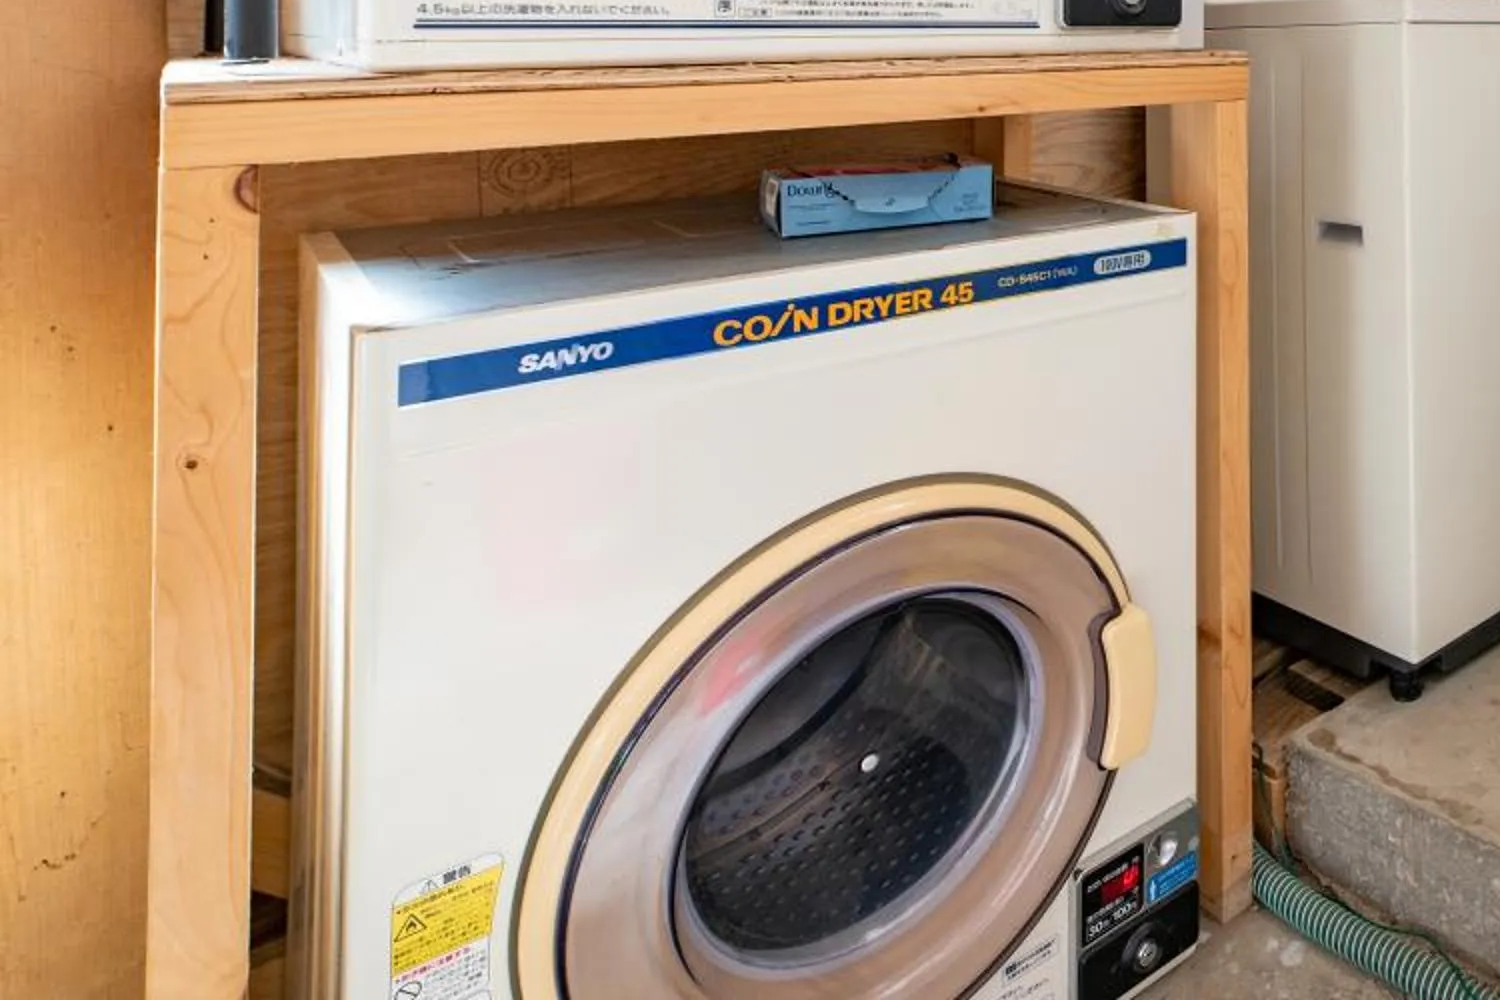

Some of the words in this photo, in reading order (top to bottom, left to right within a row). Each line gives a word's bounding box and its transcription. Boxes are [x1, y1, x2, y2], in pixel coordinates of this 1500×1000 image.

[827, 289, 932, 327] DRYER
[939, 281, 974, 305] 45
[518, 340, 614, 375] SANYO
